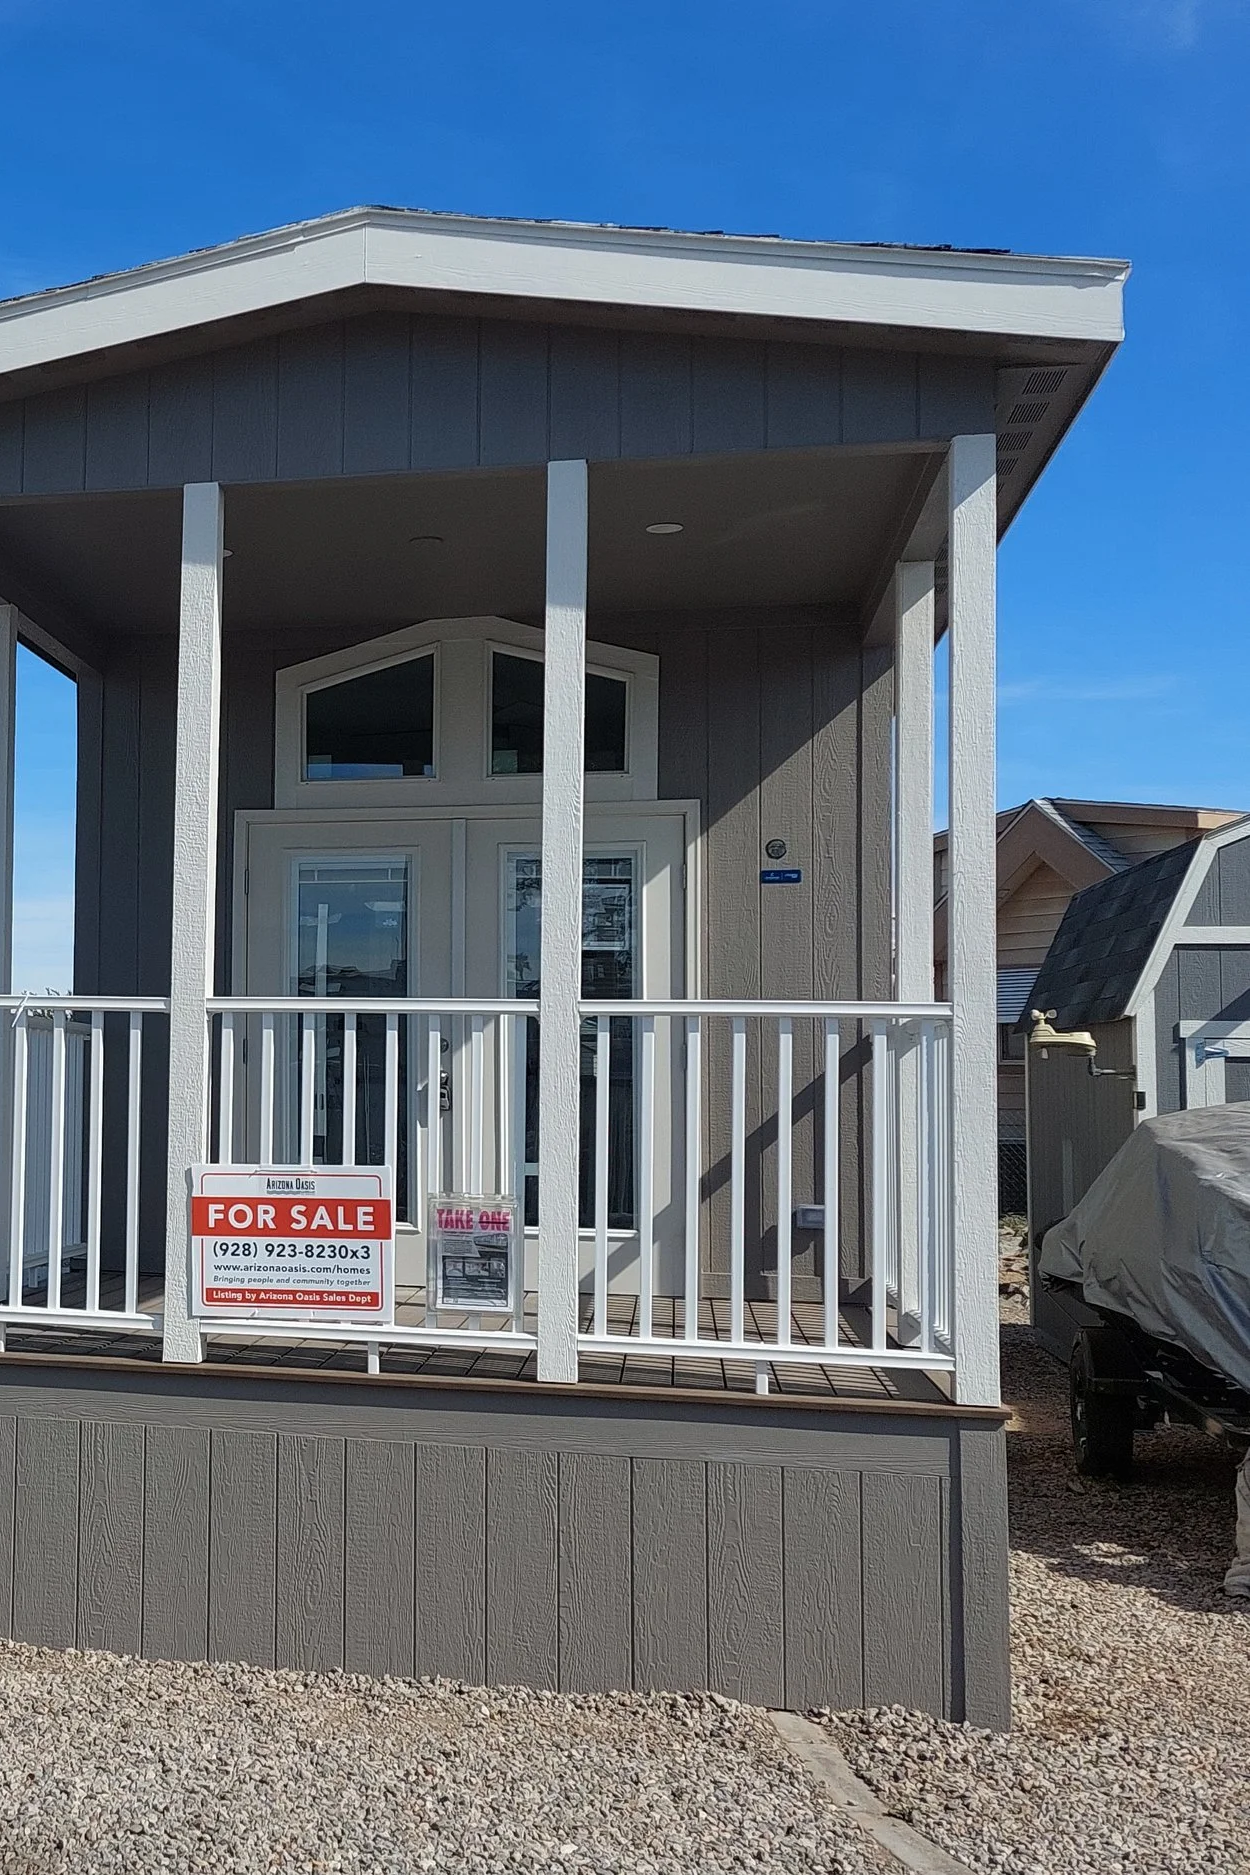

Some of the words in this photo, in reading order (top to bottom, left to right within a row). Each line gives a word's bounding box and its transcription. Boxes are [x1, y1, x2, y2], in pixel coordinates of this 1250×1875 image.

[207, 1203, 277, 1229] FOR
[290, 1205, 375, 1231] SALE
[436, 1208, 474, 1230] TAKE
[479, 1210, 510, 1231] ONE
[213, 1241, 258, 1259] (928)
[264, 1243, 371, 1260] 923-8230x3
[213, 1263, 371, 1275] www.arizonaoasis.com/homes
[213, 1275, 245, 1284] Bringing
[247, 1276, 274, 1284] people
[276, 1276, 290, 1284] and
[292, 1277, 334, 1287] community
[337, 1279, 371, 1287] together
[213, 1290, 243, 1301] Listing
[245, 1291, 257, 1301] by
[259, 1291, 293, 1301] Arizona
[295, 1292, 321, 1301] Oasis
[323, 1293, 346, 1302] Sales
[348, 1294, 371, 1304] Dept
